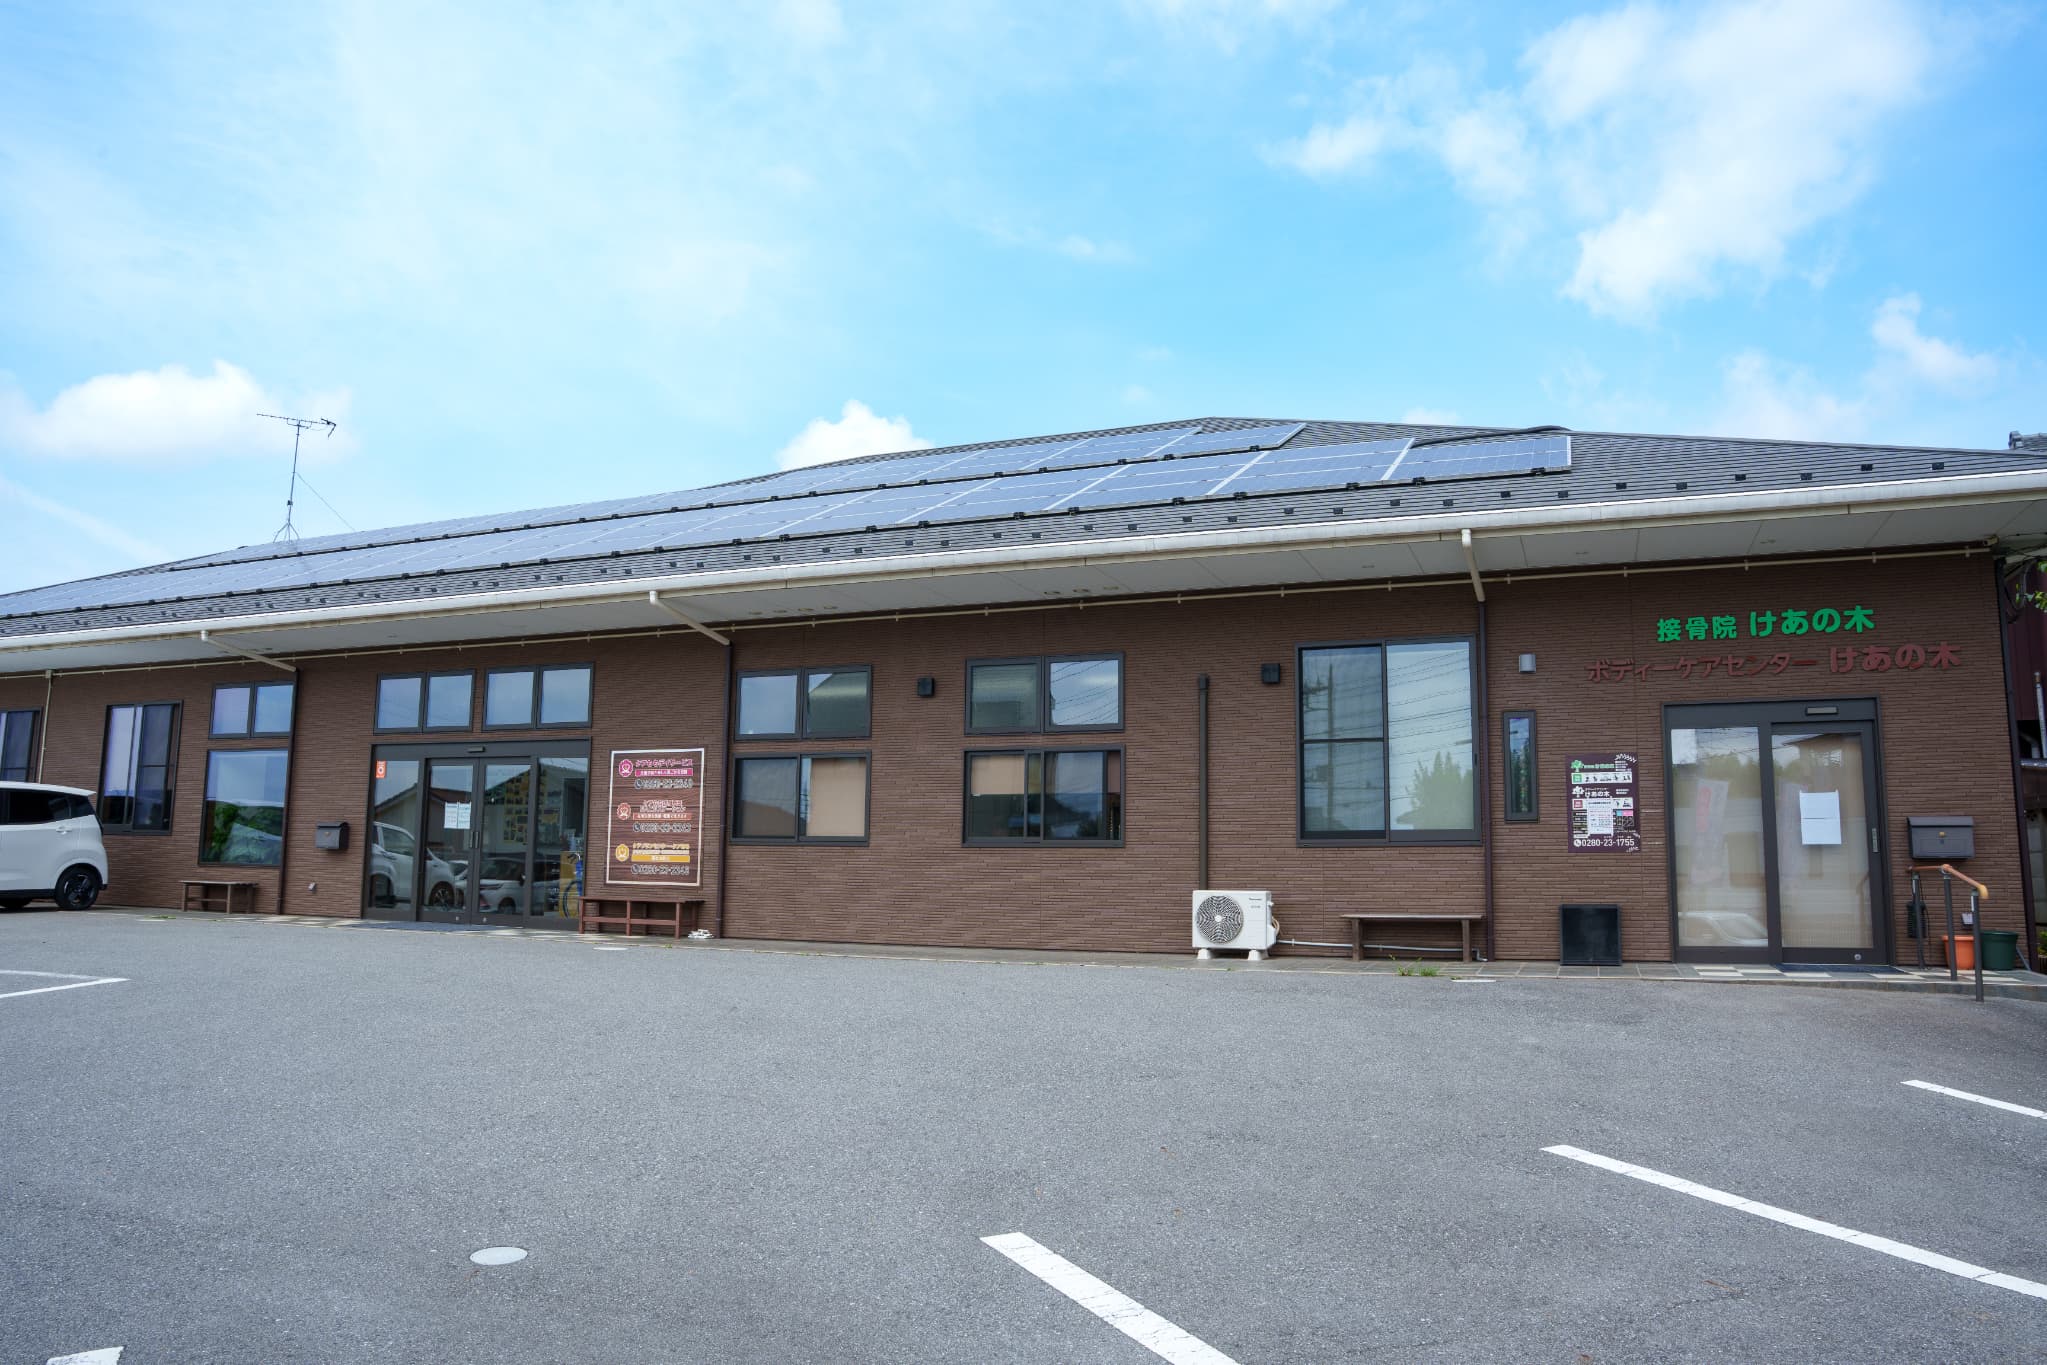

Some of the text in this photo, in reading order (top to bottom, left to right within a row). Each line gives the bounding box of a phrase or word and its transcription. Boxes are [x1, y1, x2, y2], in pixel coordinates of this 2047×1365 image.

[1657, 604, 1875, 642] 接骨院 けあの木
[1586, 642, 1961, 682] ボディーケアセンター けあの木
